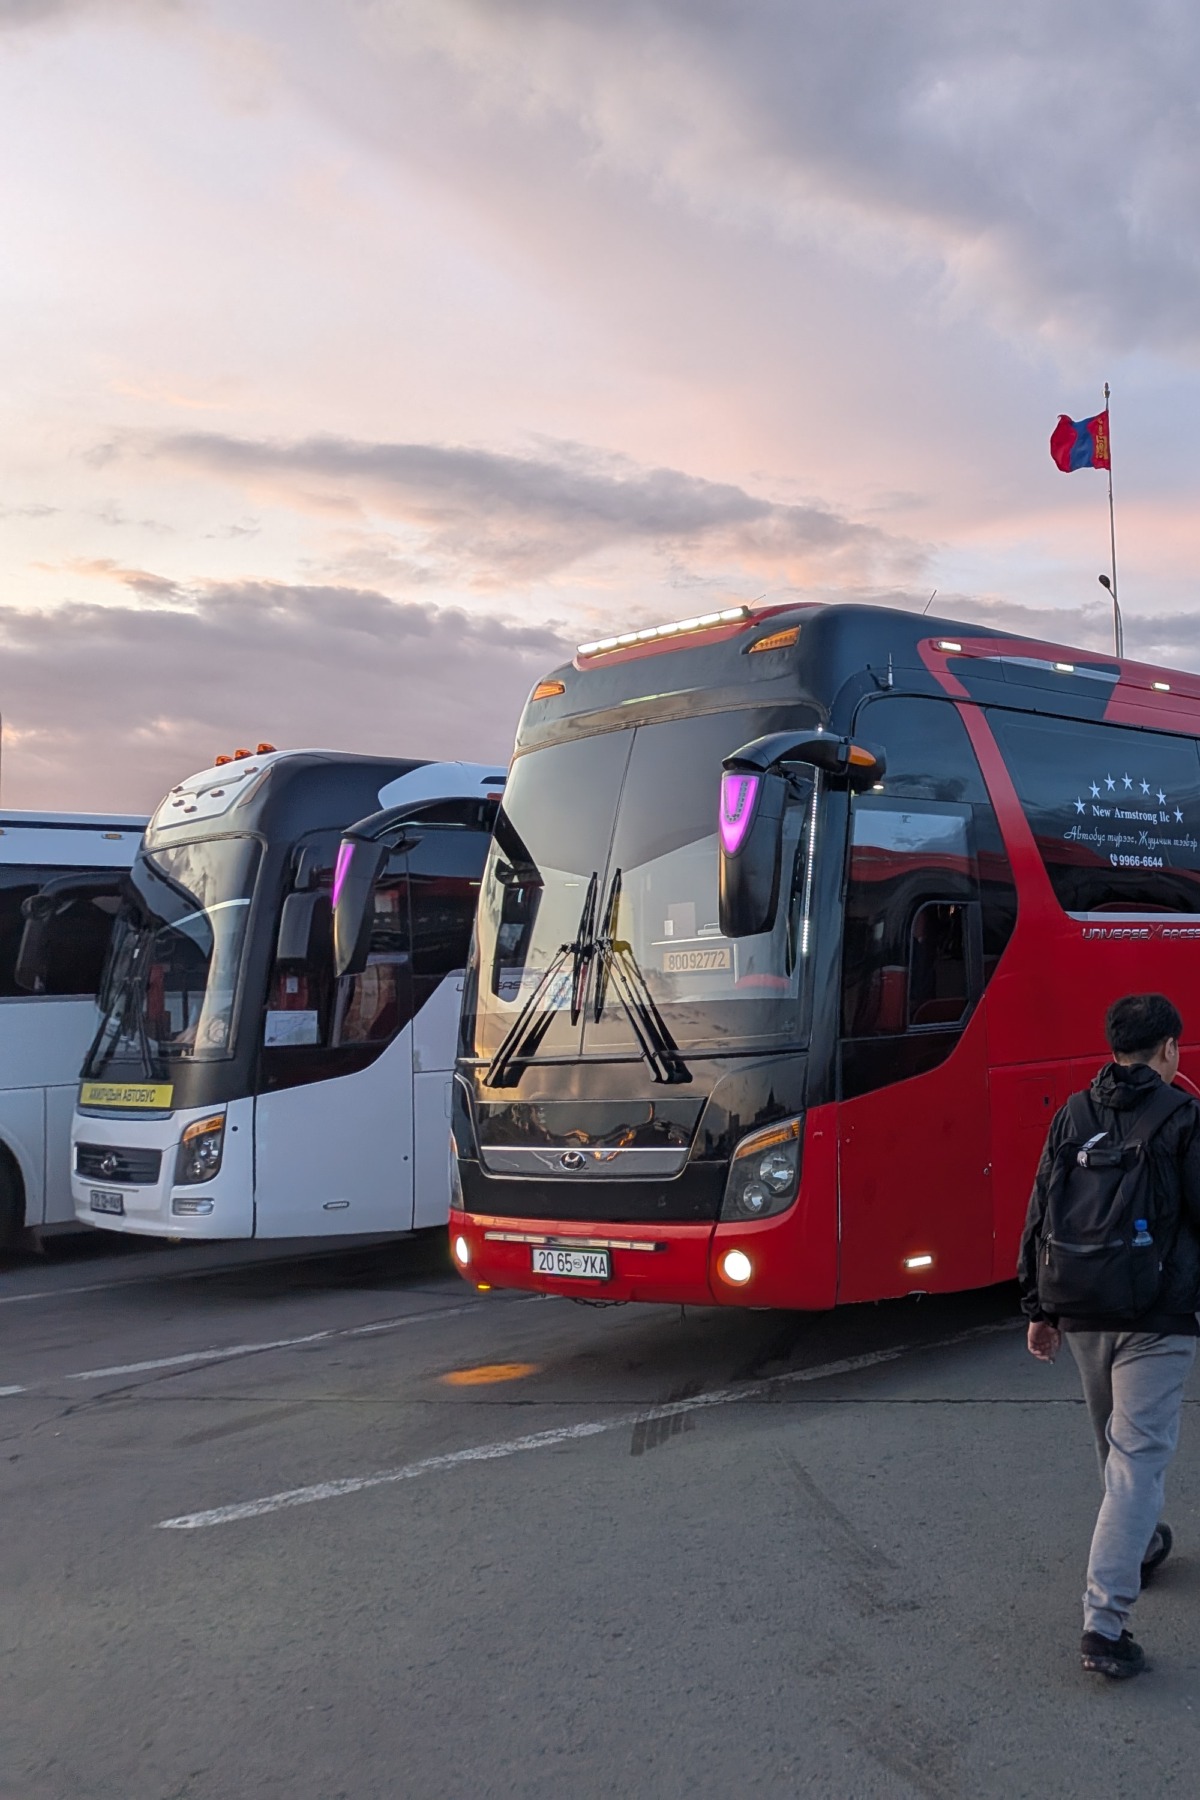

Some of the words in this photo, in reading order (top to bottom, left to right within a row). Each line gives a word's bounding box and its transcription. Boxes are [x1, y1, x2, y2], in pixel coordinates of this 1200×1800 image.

[1092, 805, 1111, 817] New
[1114, 807, 1158, 825] Armstrong
[1118, 855, 1163, 867] 9966-6644
[668, 950, 726, 970] 80092772
[582, 1255, 607, 1275] УКА
